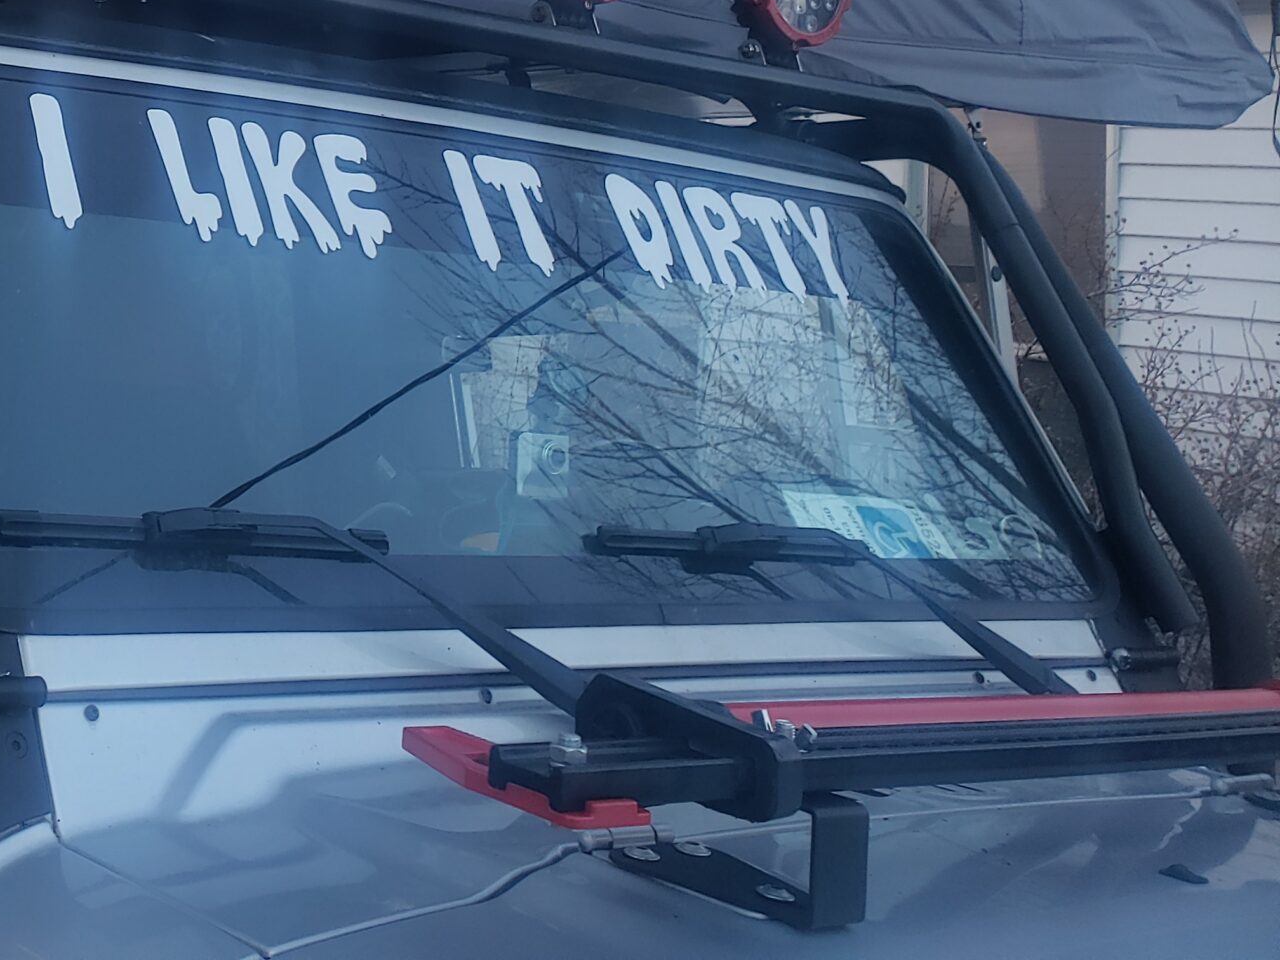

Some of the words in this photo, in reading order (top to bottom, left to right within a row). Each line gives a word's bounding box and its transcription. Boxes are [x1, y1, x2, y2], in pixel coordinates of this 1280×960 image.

[29, 92, 84, 230] I
[146, 108, 393, 259] LIKE
[442, 149, 556, 278] IT
[604, 173, 850, 307] DIRTY
